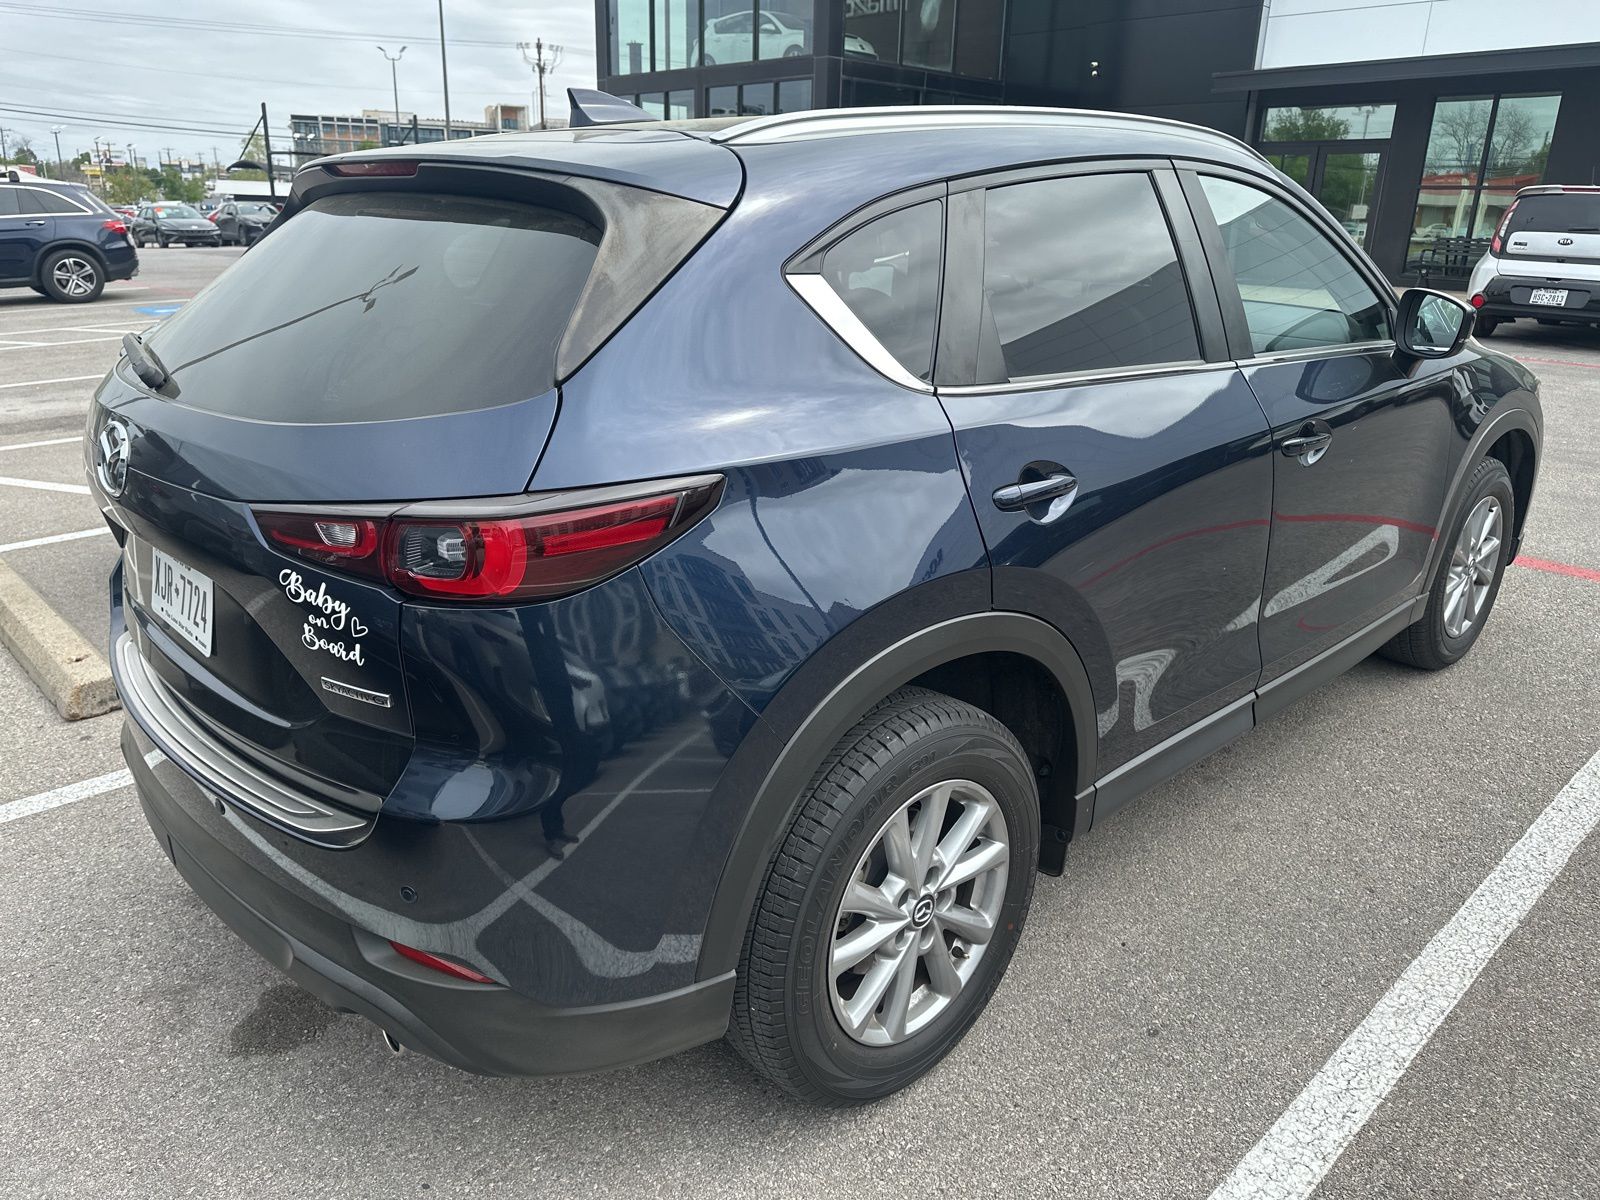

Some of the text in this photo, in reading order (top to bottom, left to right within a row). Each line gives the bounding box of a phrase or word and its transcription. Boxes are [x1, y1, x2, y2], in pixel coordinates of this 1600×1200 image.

[154, 555, 207, 634] XJR 7724
[279, 568, 351, 631] Baby
[301, 623, 365, 666] Board
[308, 614, 330, 629] on
